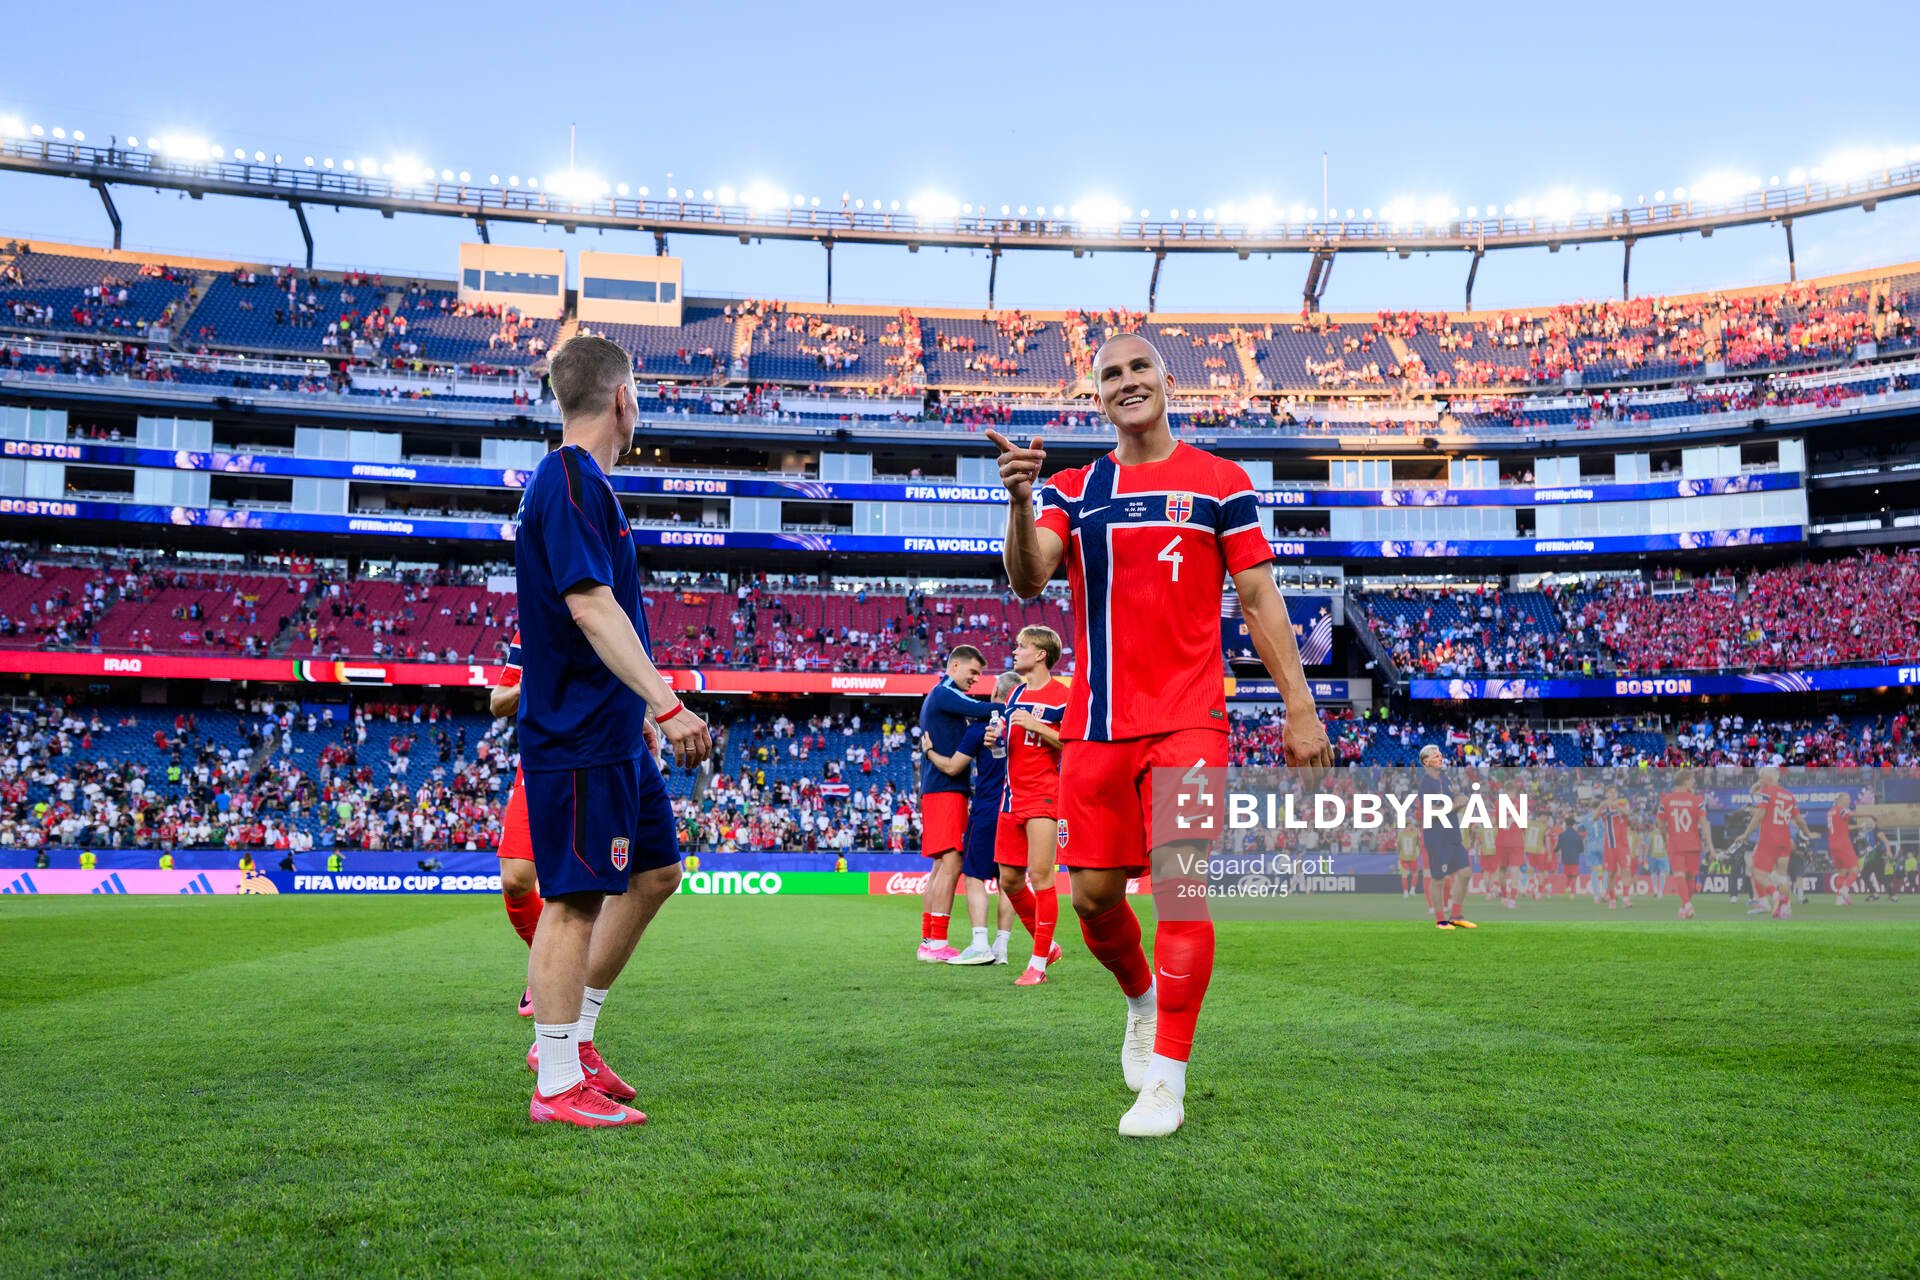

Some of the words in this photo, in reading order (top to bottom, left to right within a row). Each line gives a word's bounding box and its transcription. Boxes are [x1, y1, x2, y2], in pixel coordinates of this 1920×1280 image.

[4, 441, 81, 459] BOSTON
[352, 464, 417, 480] #FIFAWorldCup
[663, 479, 727, 493] BOSTON
[905, 486, 937, 499] FIFA
[937, 487, 989, 500] WORLD
[990, 490, 1009, 501] CU
[1258, 492, 1305, 504] OSTON
[1534, 488, 1594, 501] #FIFAWorldCup
[0, 499, 77, 516] BOSTON
[349, 519, 414, 534] #FIFAWorldCup
[661, 532, 725, 546] BOSTON
[904, 538, 936, 551] FIFA
[936, 538, 988, 552] WORLD
[1535, 540, 1595, 552] #FIFAWorldCup
[1157, 534, 1184, 582] 4
[104, 658, 142, 672] IRAQ
[469, 665, 488, 685] 1
[832, 676, 887, 689] NORWAY
[1616, 679, 1691, 695] BOSTON
[1182, 758, 1209, 805] 4
[1670, 807, 1693, 833] 10
[294, 875, 334, 890] FIFA
[336, 875, 401, 891] WORLD
[403, 875, 440, 891] CUP
[441, 875, 502, 891] 2026
[675, 871, 782, 895] ramco
